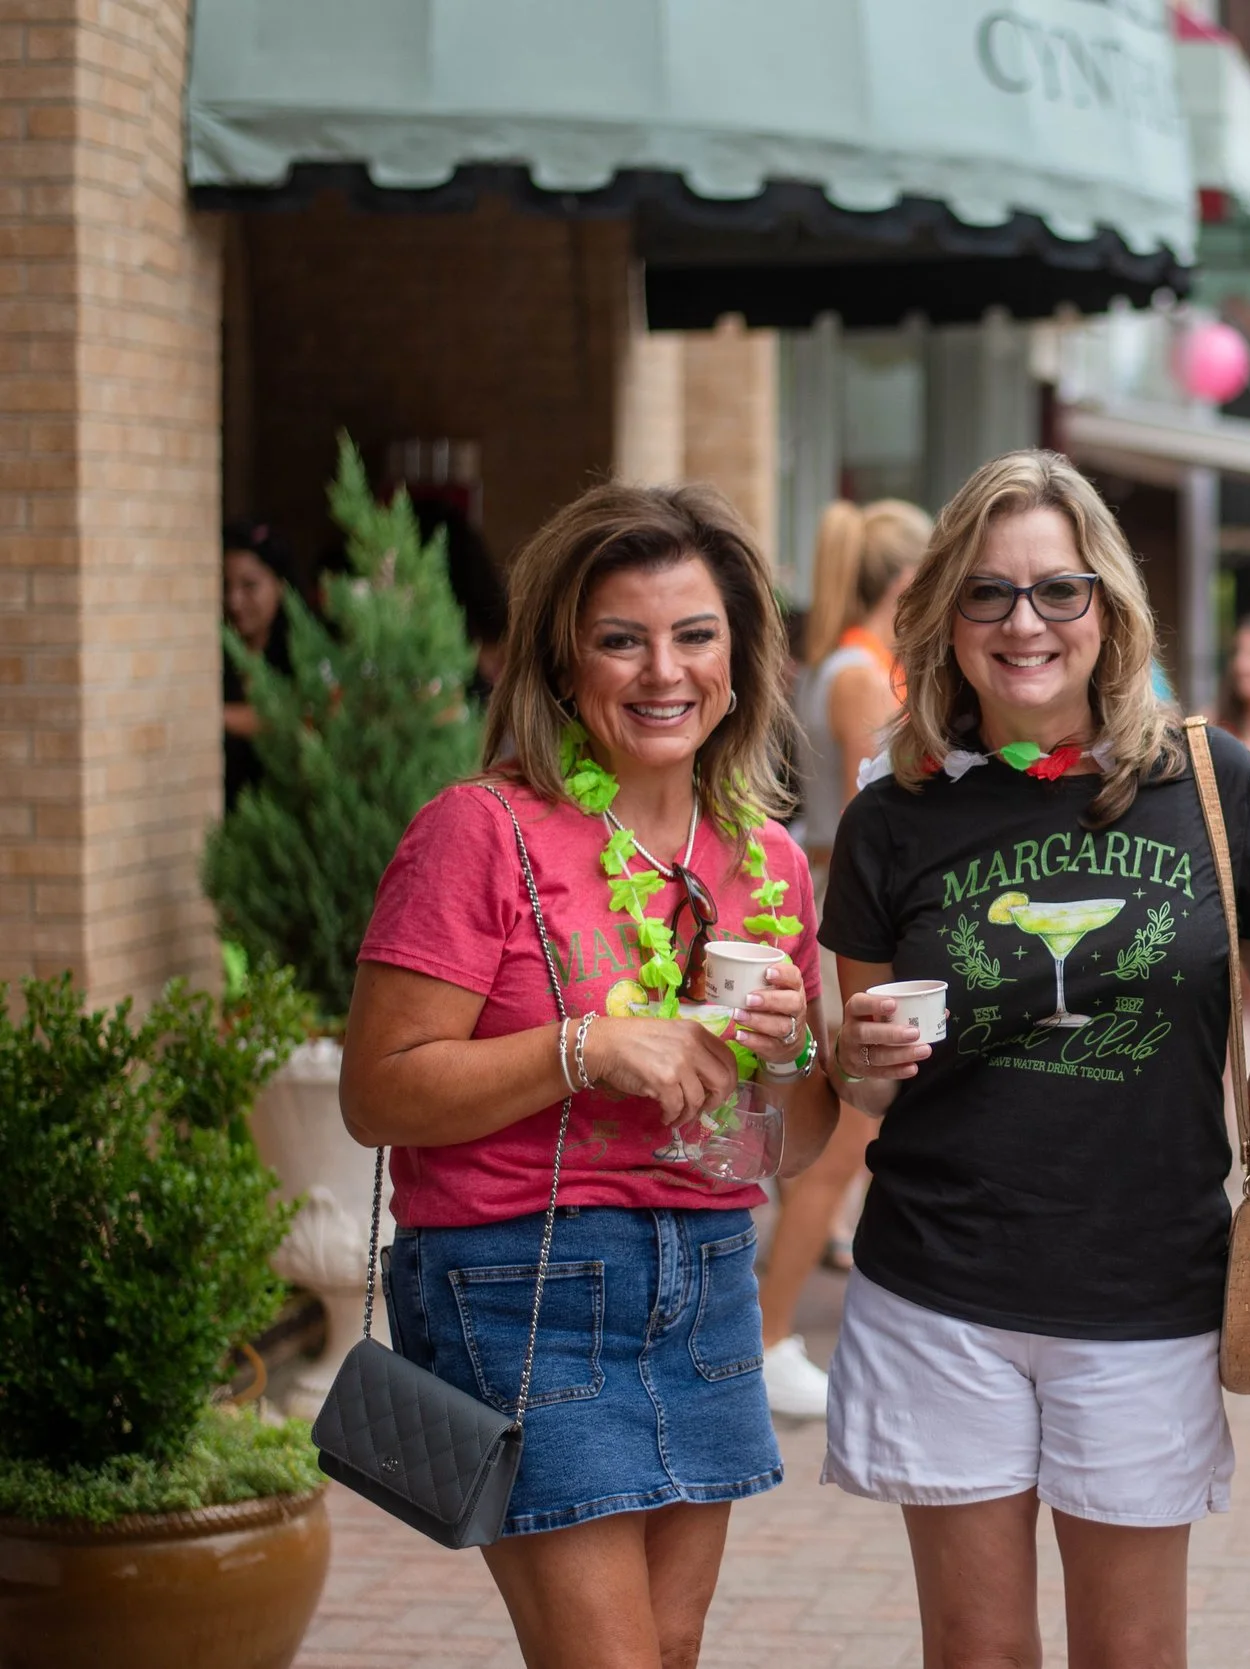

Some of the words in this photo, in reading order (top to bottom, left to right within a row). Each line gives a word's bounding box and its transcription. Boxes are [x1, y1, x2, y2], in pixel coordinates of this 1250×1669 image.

[942, 830, 1195, 909] MARGARITA
[1060, 1012, 1172, 1064] Club
[988, 1056, 1012, 1068] SAVE
[1013, 1058, 1046, 1072] WATER
[1047, 1062, 1078, 1077] DRINK
[1080, 1066, 1125, 1082] TEQUILA
